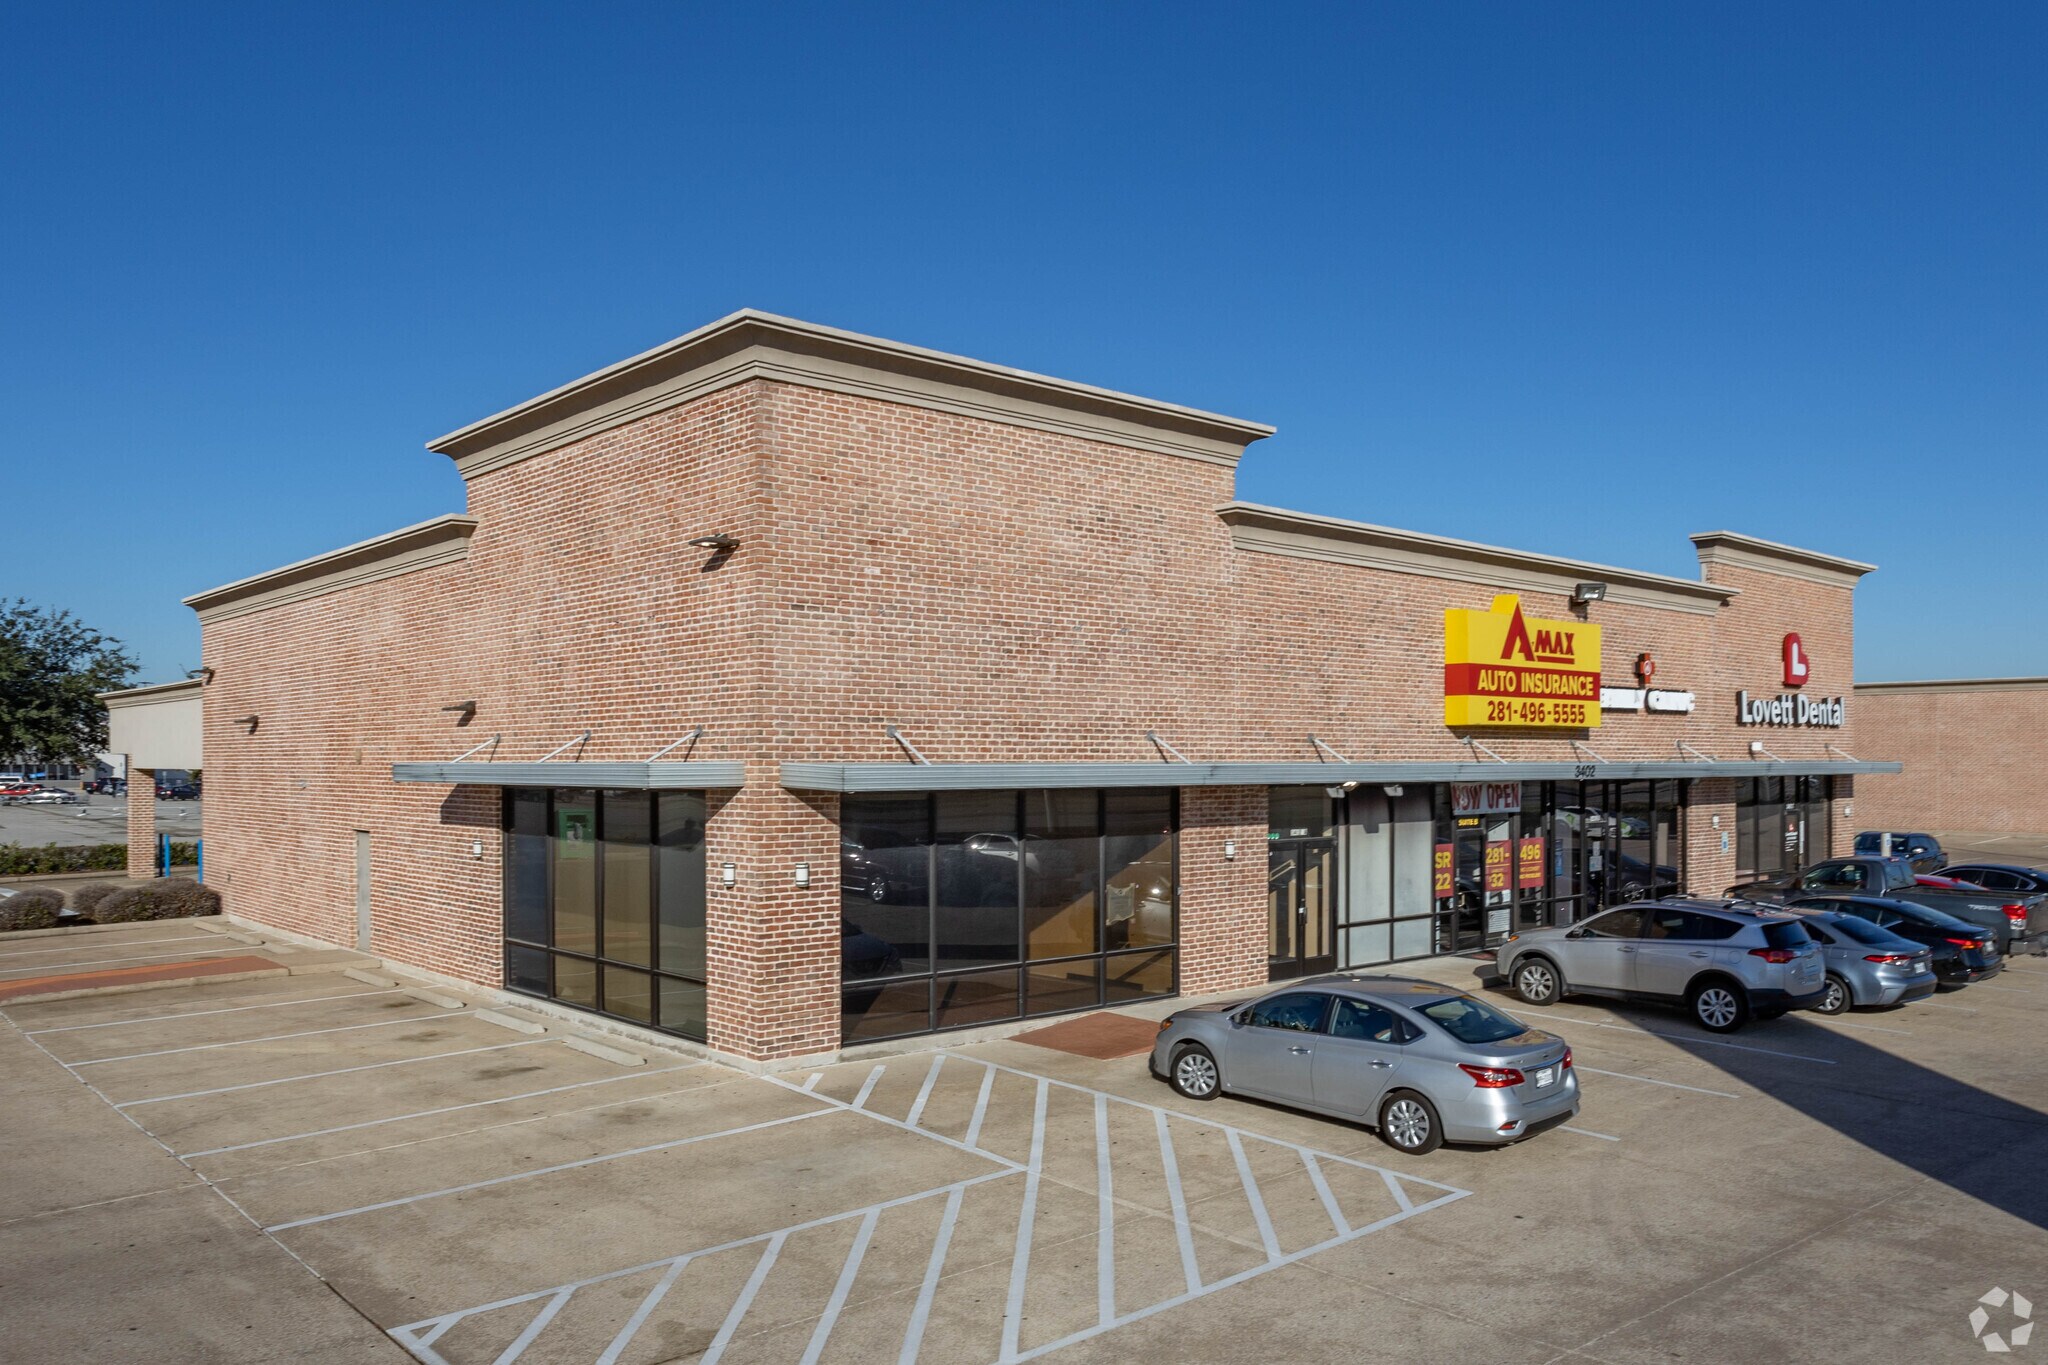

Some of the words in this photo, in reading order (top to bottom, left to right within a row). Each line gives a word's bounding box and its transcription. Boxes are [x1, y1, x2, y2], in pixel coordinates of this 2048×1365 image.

[1791, 642, 1807, 676] L
[1477, 669, 1517, 692] AUTO
[1521, 672, 1594, 696] INSURANCE
[1487, 700, 1586, 724] 281-496-5555
[1741, 690, 1794, 724] Lovett
[1797, 693, 1845, 726] Dental
[1574, 765, 1596, 778] 3402
[1452, 784, 1482, 810] NOW
[1486, 783, 1520, 809] OPEN
[1435, 852, 1451, 869] SR
[1520, 844, 1541, 860] 496
[1435, 873, 1451, 890] 22
